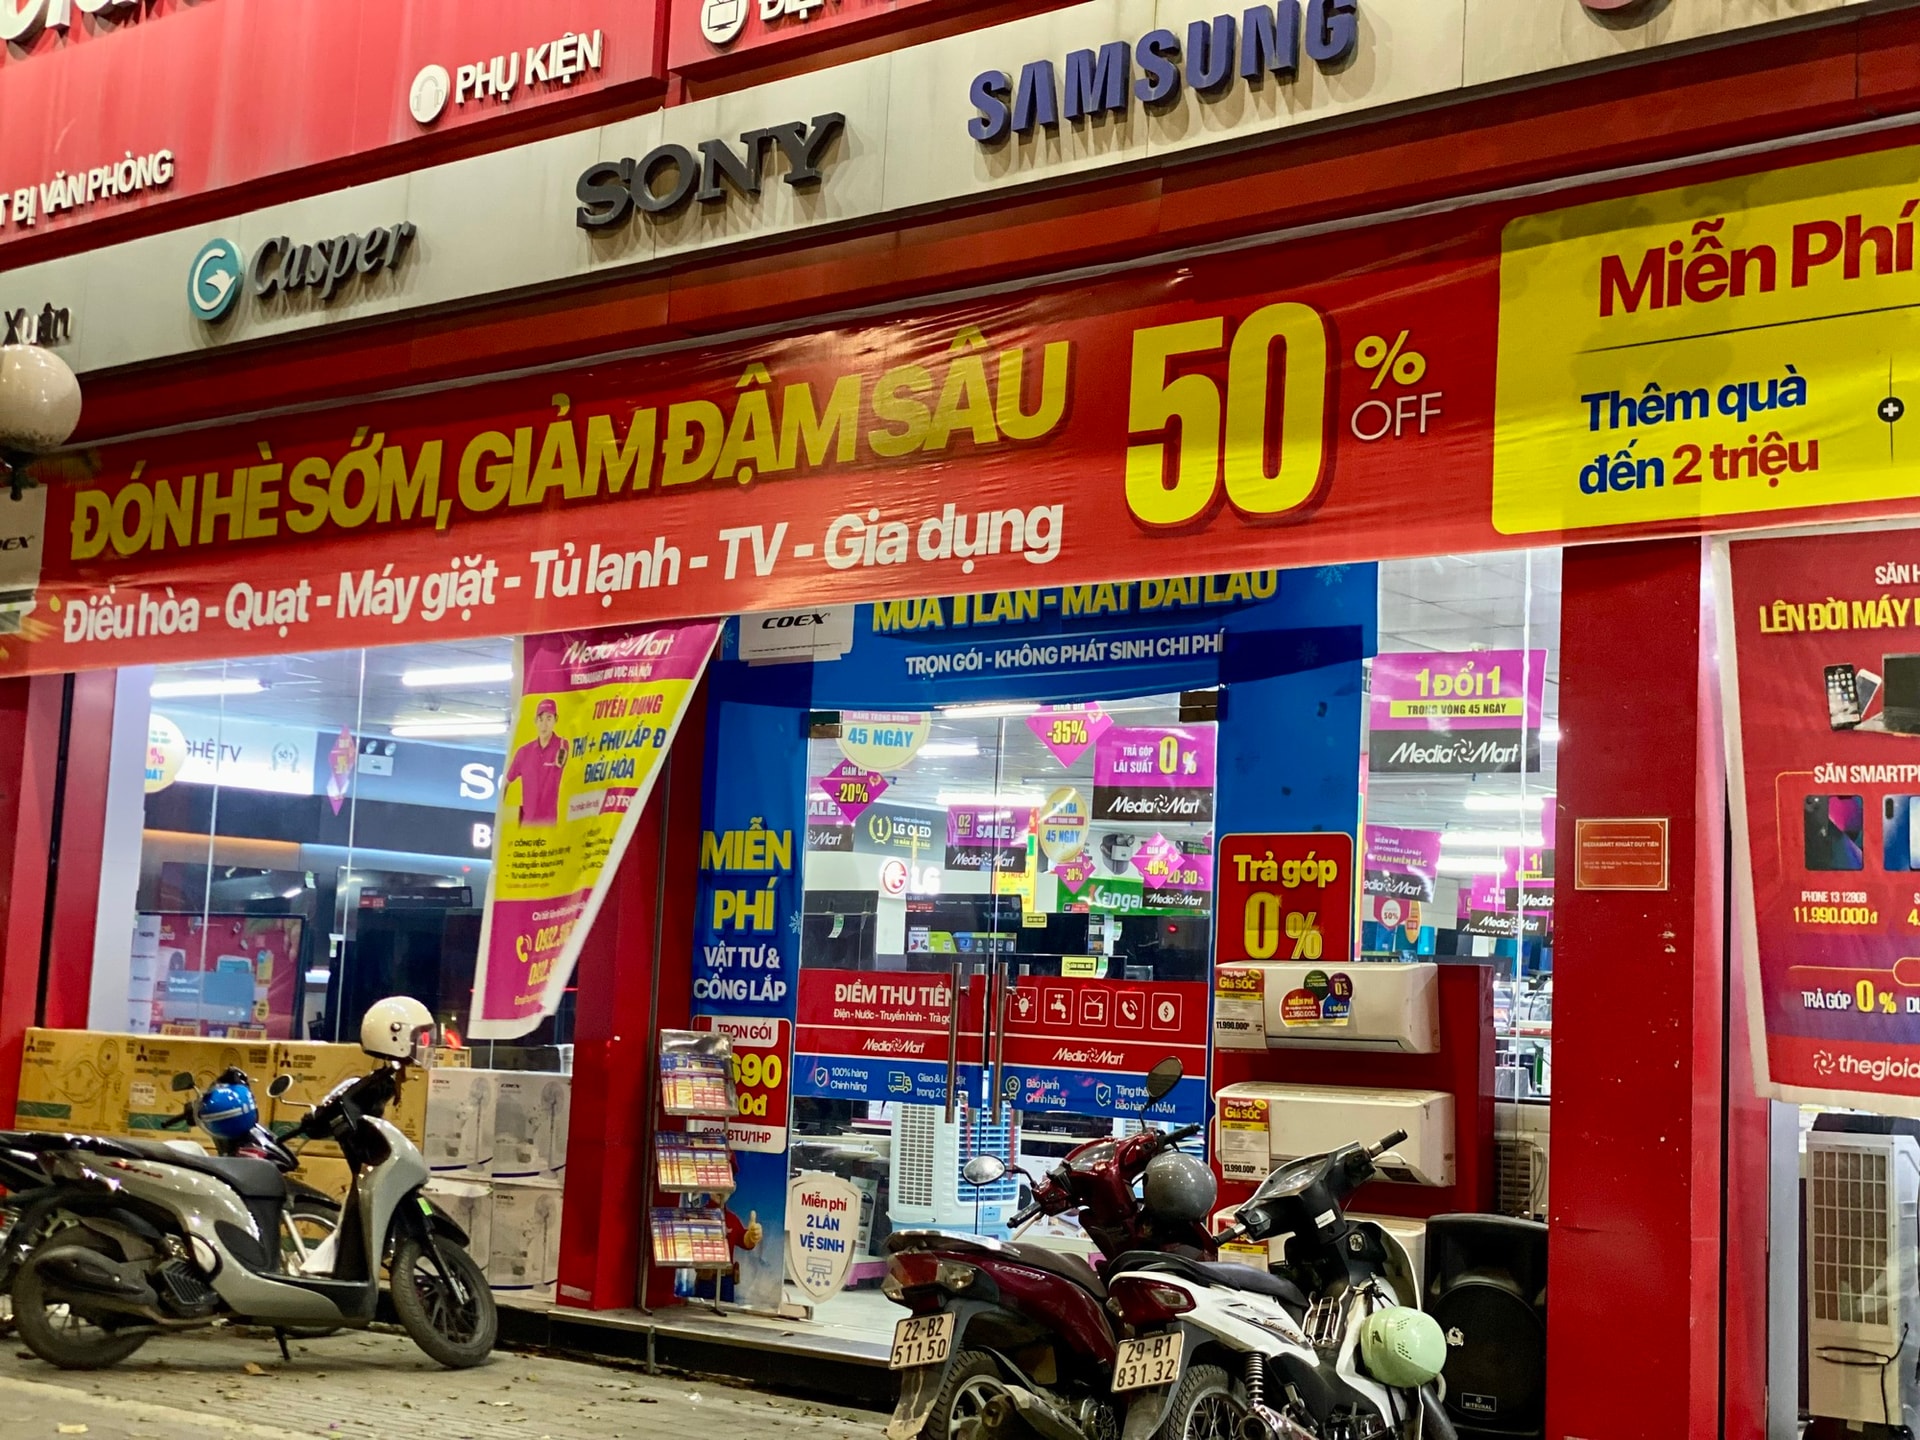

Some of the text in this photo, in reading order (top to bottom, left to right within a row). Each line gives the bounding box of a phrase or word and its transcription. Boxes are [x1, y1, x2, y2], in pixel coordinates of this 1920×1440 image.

[456, 29, 602, 102] PHỤ KIỆN
[968, 0, 1357, 143] SAMSUNG
[576, 112, 846, 230] SONY
[12, 149, 174, 225] BỊ VĂN PHÒNG
[248, 221, 416, 299] Casper
[1599, 198, 1920, 318] Miễn Phí
[1580, 364, 1807, 433] Thêm quà
[1125, 301, 1427, 526] 50 %
[1350, 391, 1443, 441] OFF
[70, 460, 196, 561] ĐÓN
[199, 441, 284, 544] HÈ
[458, 393, 657, 512] GIẢM
[660, 363, 863, 487] ĐẬM
[868, 326, 1070, 458] SÂU
[1579, 432, 1819, 495] đến 2 triệu
[64, 503, 1064, 644] Điều hòa Quạt Máy giặt Tủ lạnh TV Gia dụng
[1874, 561, 1911, 585] SĂN
[762, 612, 828, 630] COEX
[872, 596, 945, 632] MUA
[1759, 600, 1806, 634] LÊN
[1807, 597, 1849, 632] ĐỜI
[1852, 594, 1911, 629] MÁY
[905, 628, 1225, 678] TRỌN GÓI KHÔNG PHÁT SINH CHI PHÍ
[1415, 660, 1501, 697] 1 ĐỔI 1
[1468, 703, 1480, 714] 45
[1482, 702, 1507, 714] NGÀY
[847, 727, 914, 747] 45 NGÀY
[1047, 719, 1088, 745] -35%
[1113, 758, 1154, 774] LÃI SUẤT
[1159, 735, 1179, 775] 0
[1470, 741, 1519, 764] Mart
[1814, 762, 1847, 784] SĂN
[835, 783, 869, 803] -20%
[1107, 795, 1201, 815] Media Mart
[893, 823, 905, 835] LG
[958, 814, 971, 828] 02
[701, 816, 792, 870] MIỄN
[1233, 851, 1338, 888] Trả góp
[713, 876, 778, 931] PHÍ
[1244, 891, 1323, 960] 0 %
[704, 940, 780, 974] VẬT TƯ &
[693, 973, 787, 1002] CÔNG LẮP
[835, 978, 877, 1004] ĐIỂM
[880, 985, 916, 1006] THU
[1802, 979, 1898, 1014] TRẢ GÓP 0 %
[833, 1008, 851, 1020] Điện
[855, 1009, 875, 1020] Nước
[749, 1022, 772, 1040] GÓI
[899, 1039, 925, 1054] Mart
[1097, 1049, 1125, 1065] Mart
[831, 1067, 851, 1077] 100%
[917, 1072, 934, 1084] Giao
[916, 1087, 935, 1100] trong
[1155, 1101, 1176, 1114] NĂM
[801, 1192, 848, 1212] Miễn phí
[806, 1213, 840, 1231] 2 LẦN
[799, 1232, 845, 1255] VỆ SINH
[903, 1316, 944, 1342] 22-B2
[894, 1338, 947, 1365] 511.50
[1125, 1335, 1172, 1364] 29-B1
[1117, 1358, 1175, 1388] 831.32
